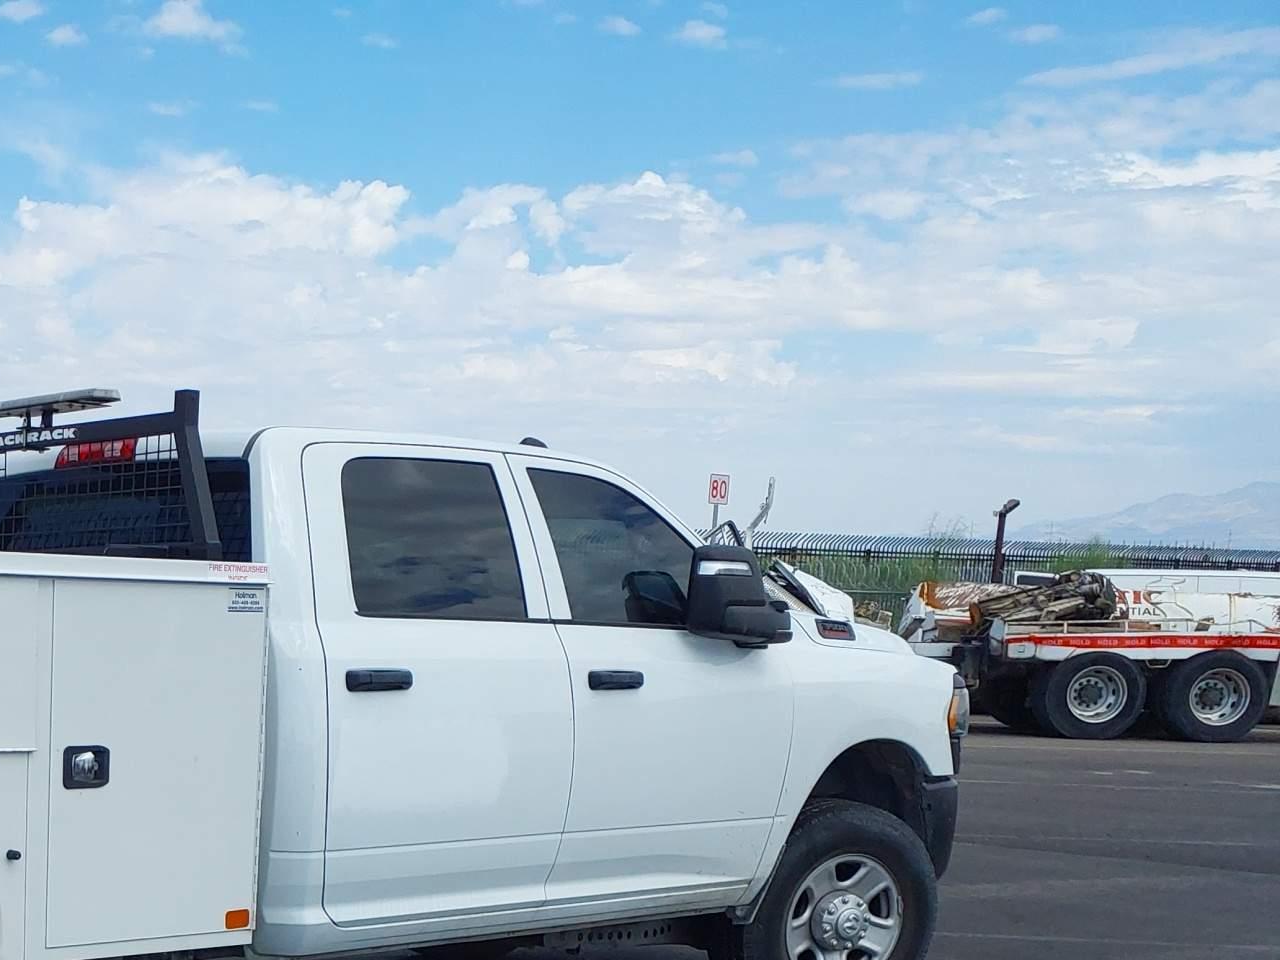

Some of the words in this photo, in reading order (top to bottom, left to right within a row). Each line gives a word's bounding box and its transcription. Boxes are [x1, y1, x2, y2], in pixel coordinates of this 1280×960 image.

[711, 479, 727, 499] 80
[208, 564, 223, 572] FIRE
[224, 565, 268, 574] EXTINGUISHER
